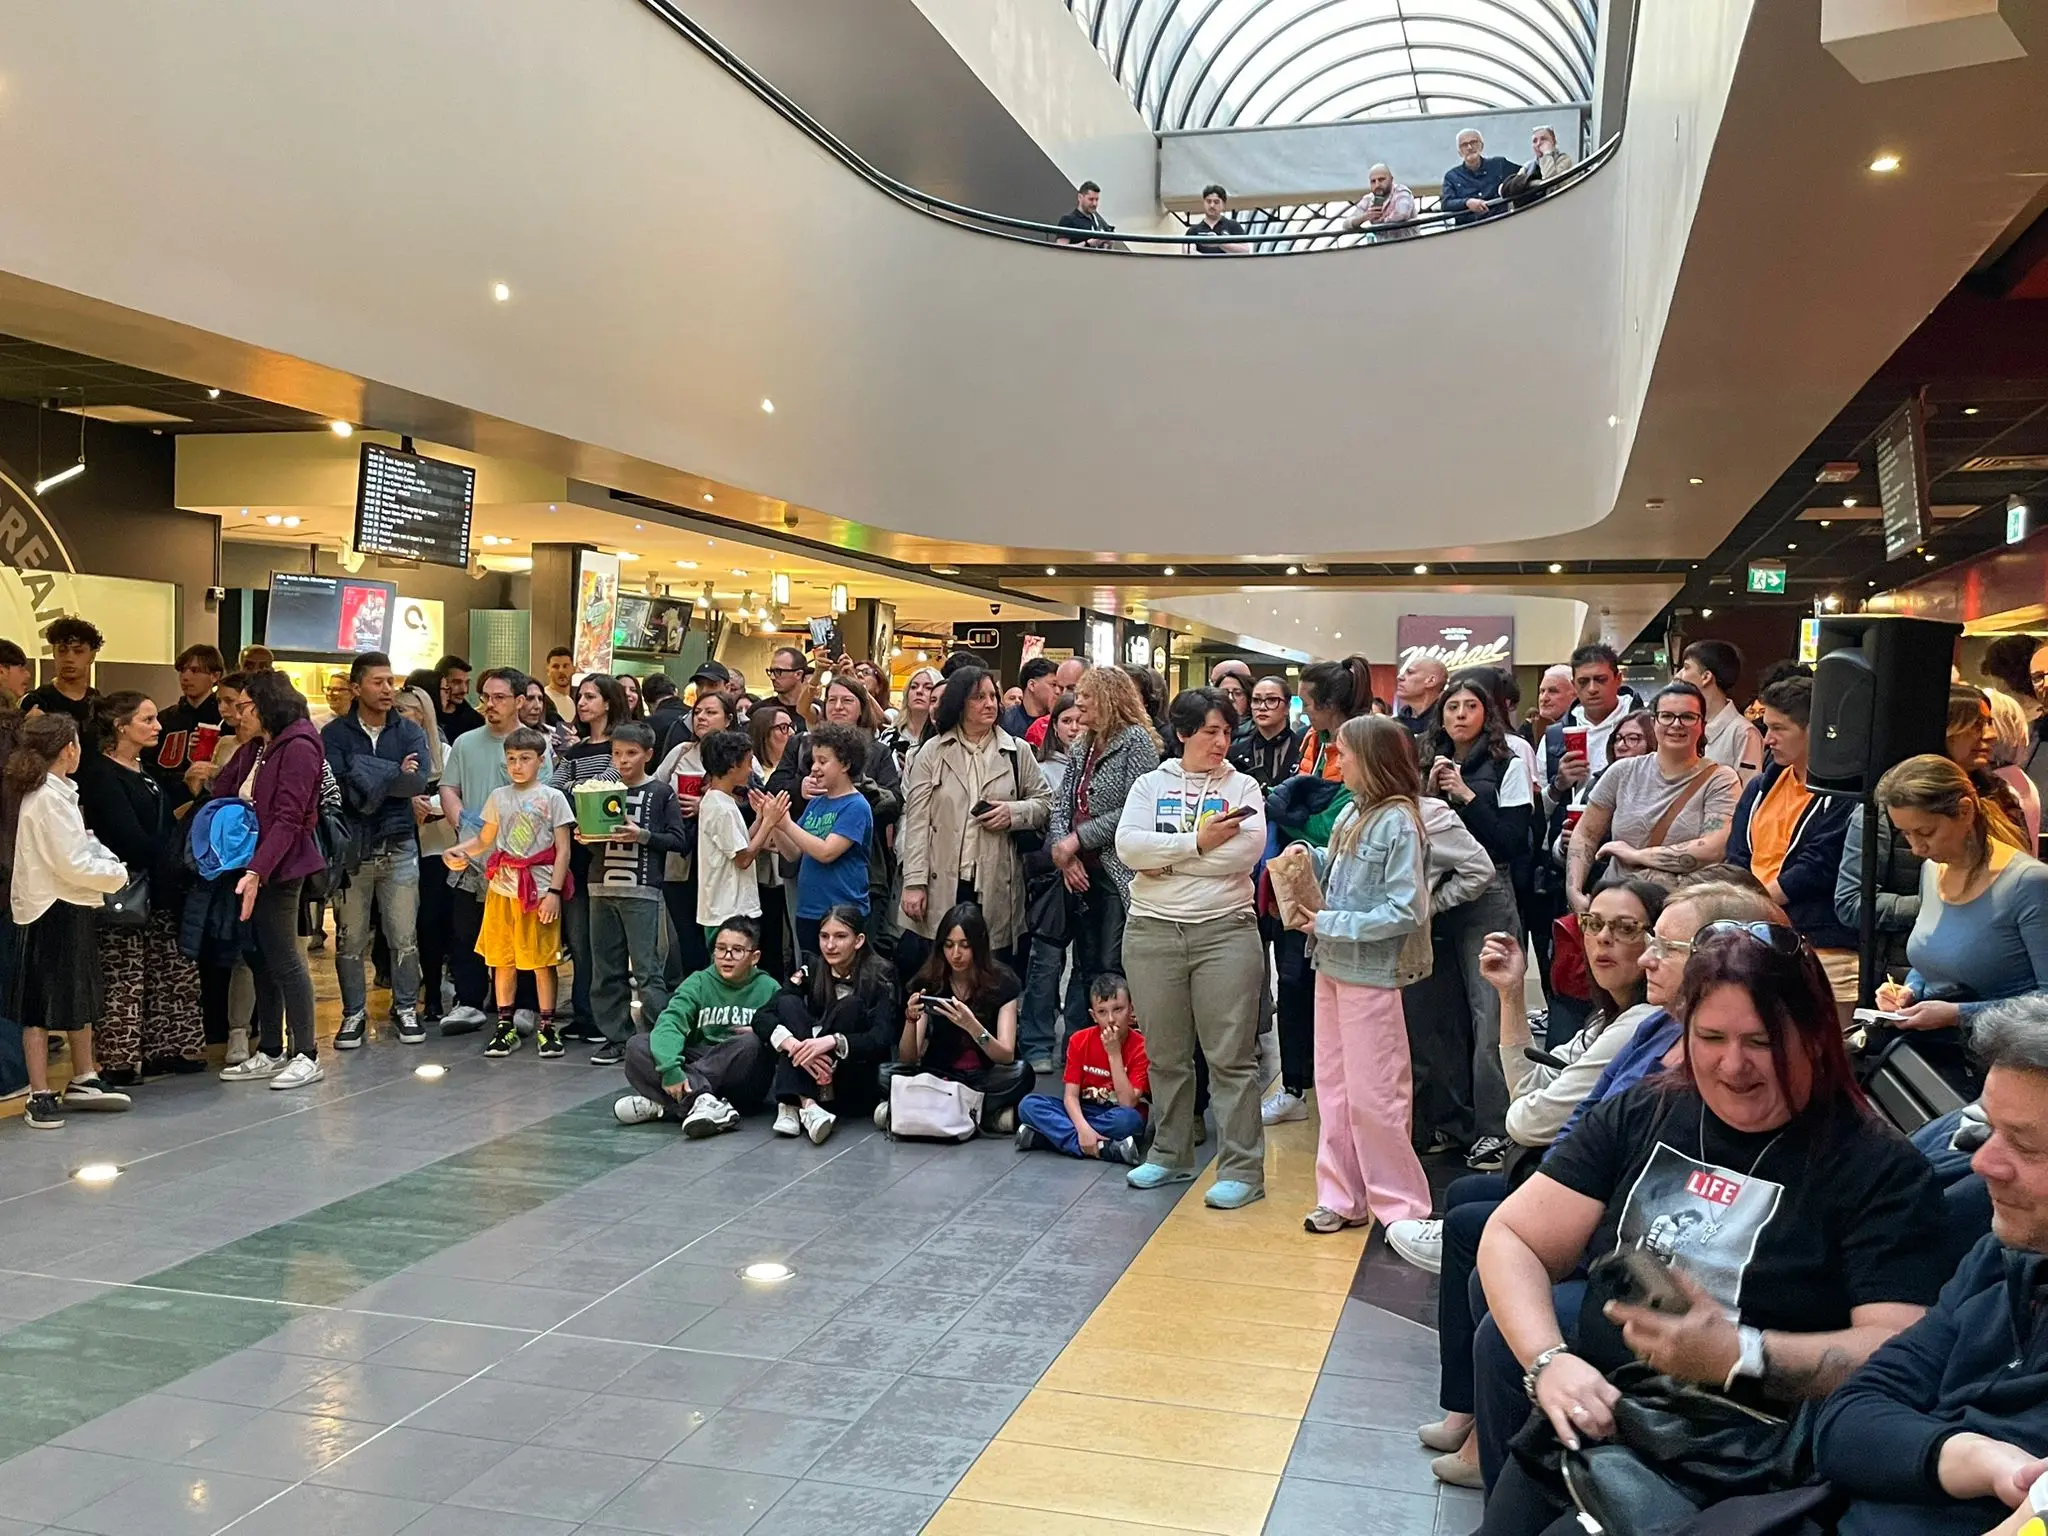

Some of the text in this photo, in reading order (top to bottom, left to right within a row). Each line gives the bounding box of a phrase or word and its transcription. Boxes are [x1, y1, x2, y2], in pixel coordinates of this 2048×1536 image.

[697, 1006, 730, 1028] TRACK
[731, 1006, 741, 1025] &
[1687, 1174, 1738, 1204] LIFE
